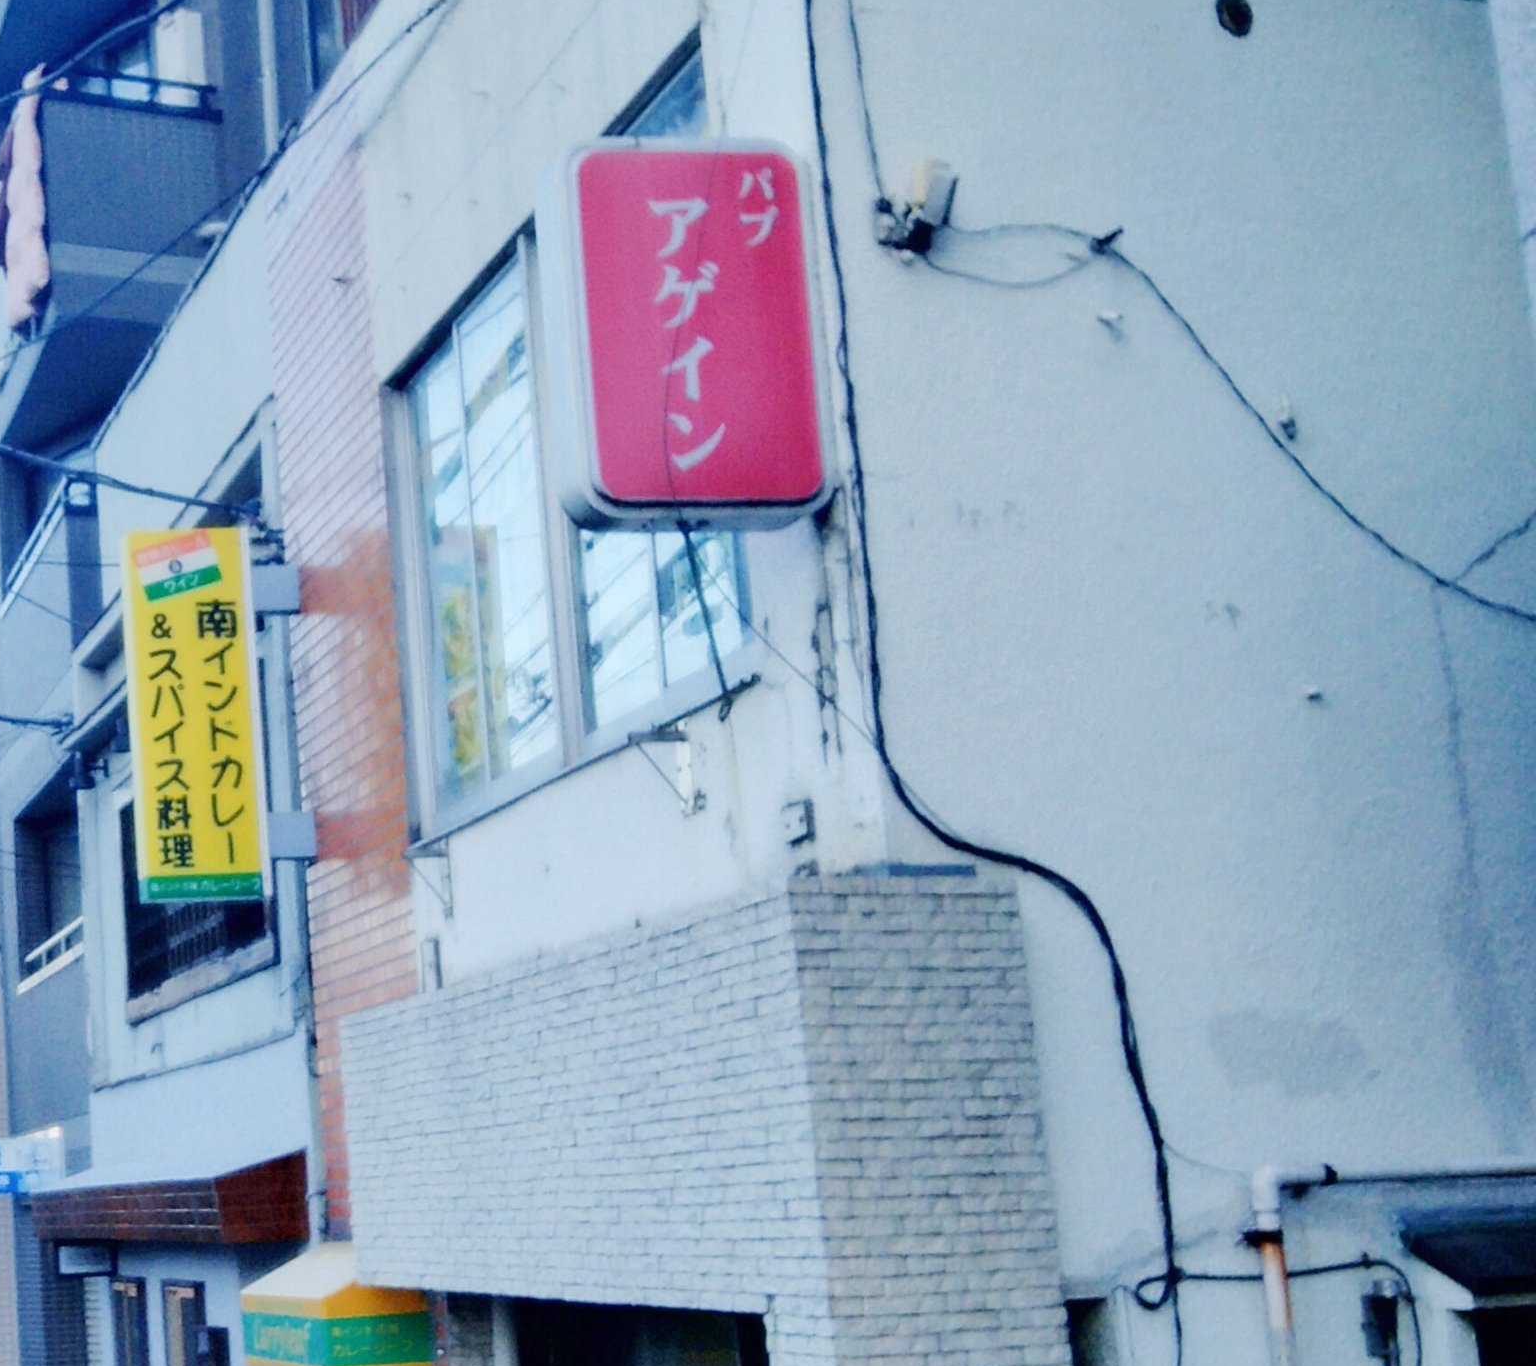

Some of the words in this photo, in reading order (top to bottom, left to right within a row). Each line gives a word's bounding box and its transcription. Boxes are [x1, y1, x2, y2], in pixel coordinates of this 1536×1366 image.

[647, 196, 727, 473] アゲイン
[148, 611, 195, 869] &スパイス料理
[195, 599, 246, 865] 南インドカレー
